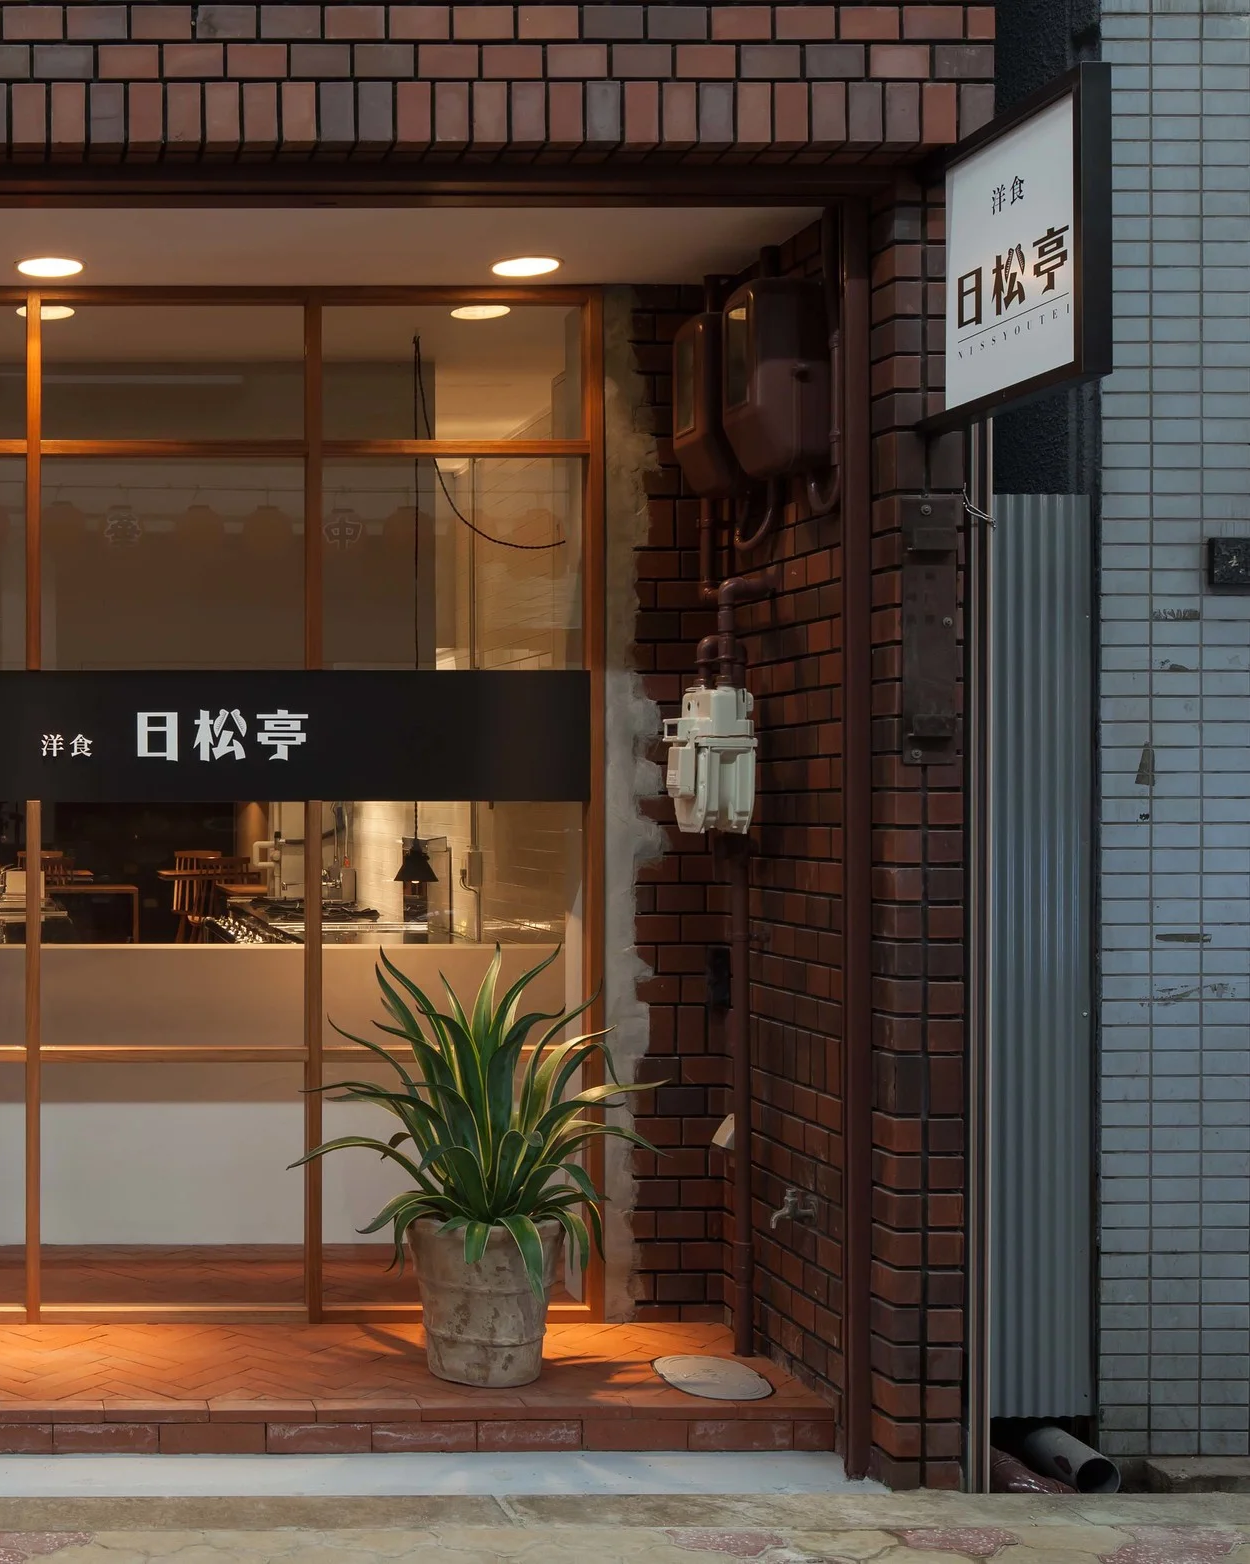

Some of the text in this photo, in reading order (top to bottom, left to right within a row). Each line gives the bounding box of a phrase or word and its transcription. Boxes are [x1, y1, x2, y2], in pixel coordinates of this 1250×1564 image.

[991, 175, 1025, 216] 洋食
[957, 224, 1070, 330] 日松亭
[957, 303, 1070, 360] NISSYOUTEI
[40, 708, 309, 762] 洋食 日松亭
